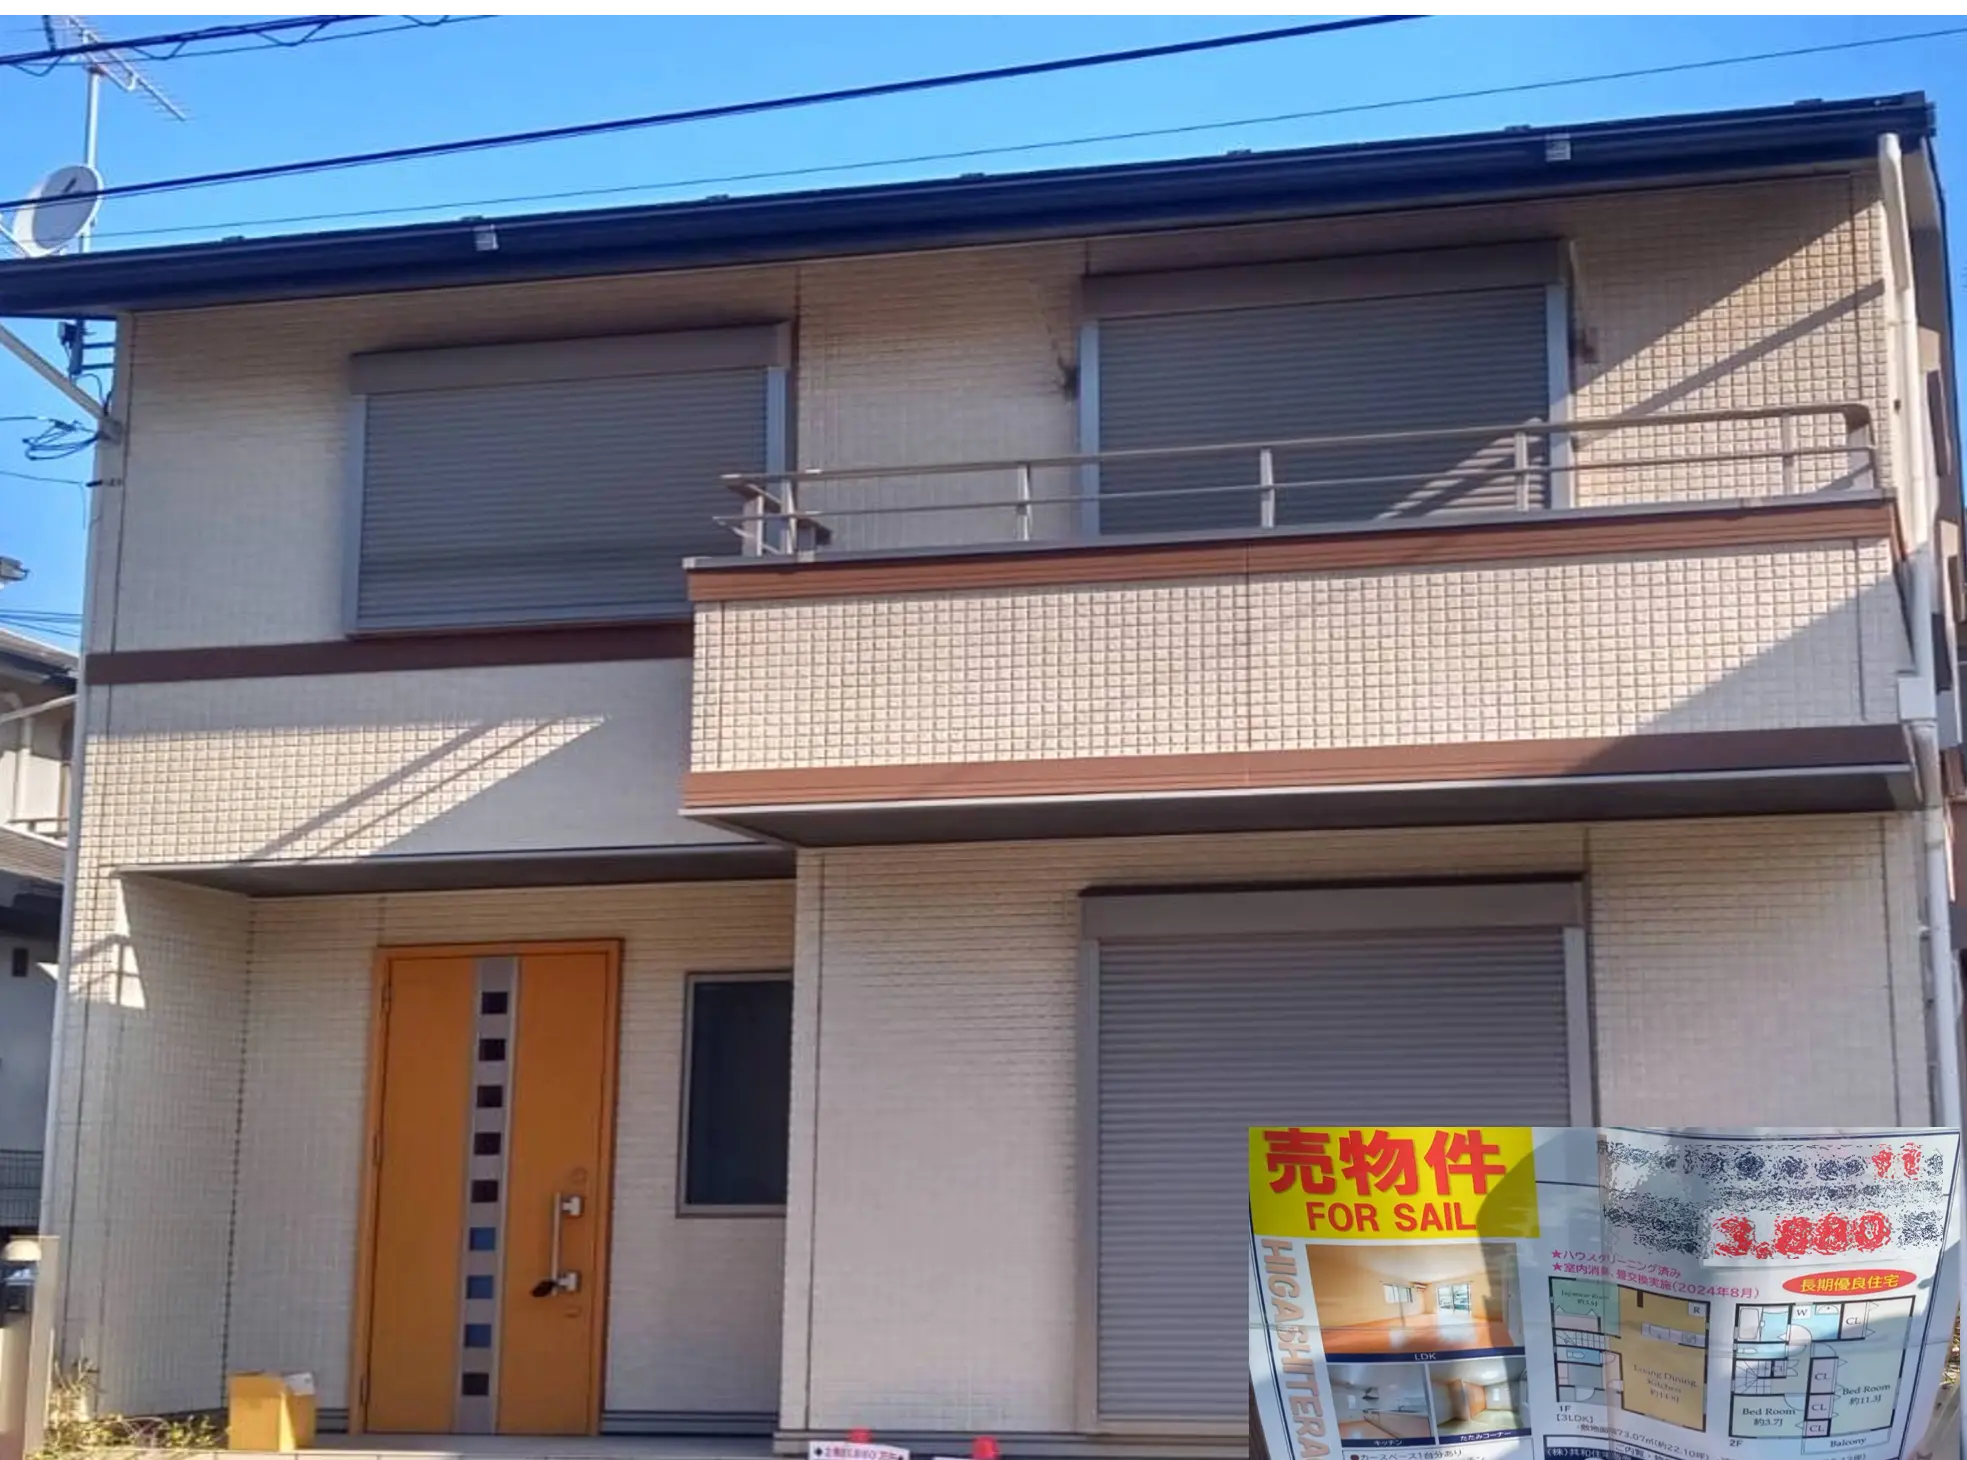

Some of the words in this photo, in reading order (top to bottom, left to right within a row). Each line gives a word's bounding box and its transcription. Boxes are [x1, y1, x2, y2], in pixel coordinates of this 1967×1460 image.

[1264, 1127, 1507, 1196] 売物件
[1305, 1201, 1380, 1232] FOR
[1393, 1202, 1477, 1232] SAIL
[1800, 1273, 1901, 1293] 長期優良住宅
[1692, 1306, 1701, 1315] R
[1796, 1309, 1808, 1317] W
[1845, 1317, 1862, 1326] CL
[1414, 1352, 1437, 1361] LDK
[1814, 1373, 1830, 1381] CL
[1842, 1387, 1861, 1396] Bed
[1863, 1383, 1891, 1393] Room
[1741, 1407, 1762, 1416] Bed
[1765, 1407, 1796, 1416] Room
[1811, 1404, 1827, 1412] CL
[1809, 1425, 1825, 1433] CL
[1460, 1431, 1513, 1442] たたみコーナー
[1373, 1439, 1403, 1447] キッチン
[1729, 1439, 1744, 1448] 2F
[1829, 1437, 1867, 1448] Balcony
